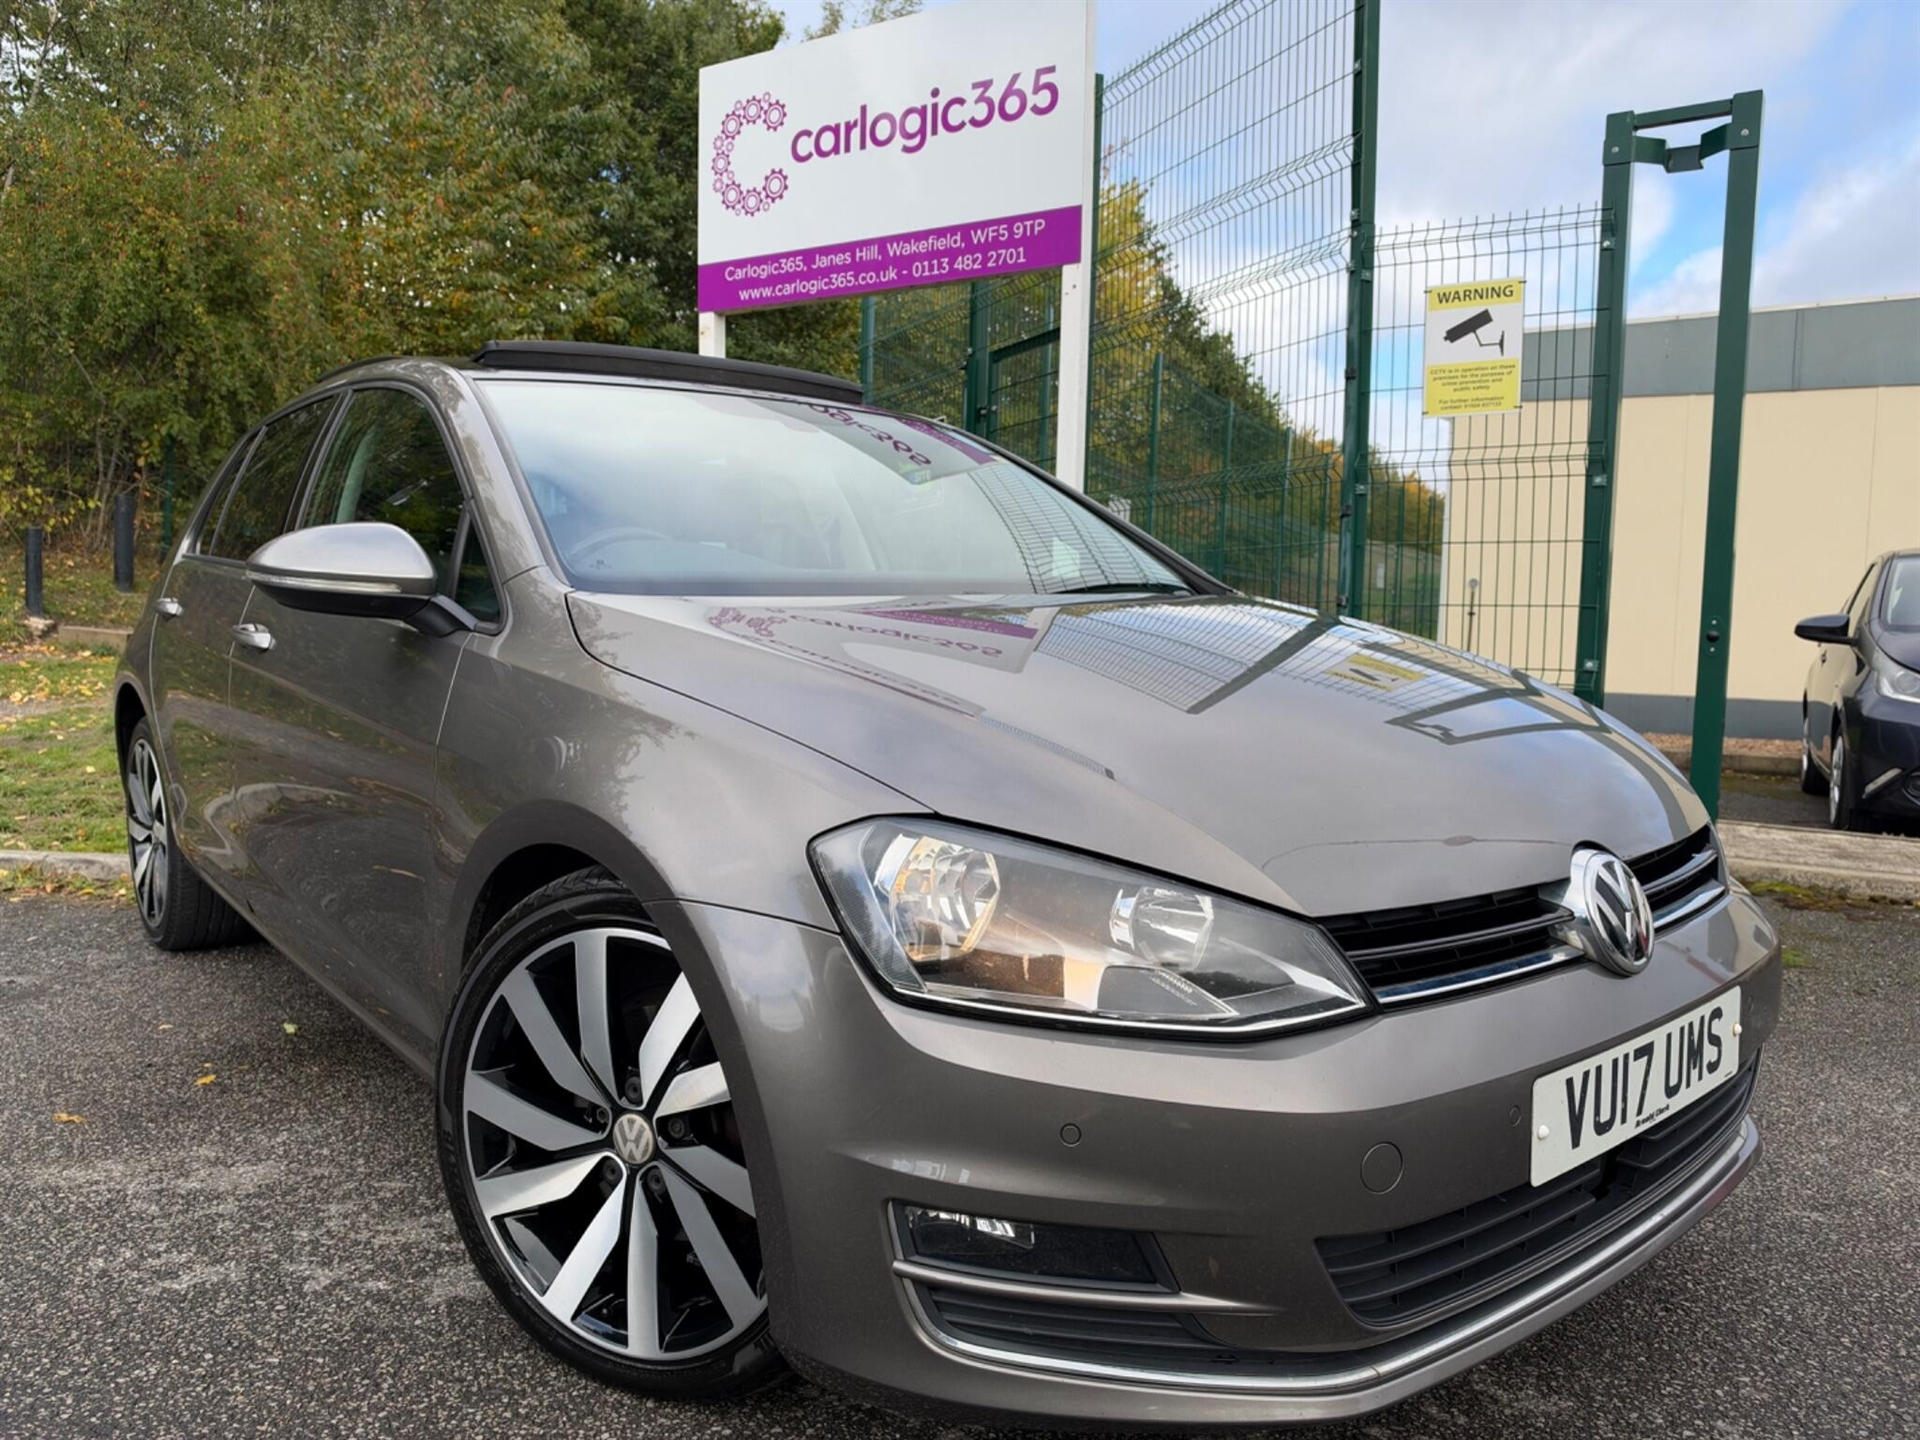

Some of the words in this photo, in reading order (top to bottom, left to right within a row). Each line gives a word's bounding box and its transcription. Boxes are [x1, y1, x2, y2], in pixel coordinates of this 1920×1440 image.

[791, 65, 1060, 163] carlogic365
[725, 255, 807, 282] Carlogic365,
[811, 249, 852, 271] Janes
[855, 243, 882, 263] Hill,
[887, 232, 966, 259] Wakefield,
[970, 225, 1009, 245] WF5
[1013, 219, 1046, 239] 9TP
[739, 268, 898, 301] www.carlogic365.co.uk
[912, 259, 949, 278] 0113
[953, 253, 982, 271] 482
[986, 247, 1026, 268] 2701
[1437, 285, 1514, 304] WARNING
[1565, 1040, 1655, 1150] VU17
[1664, 1006, 1723, 1100] UMS
